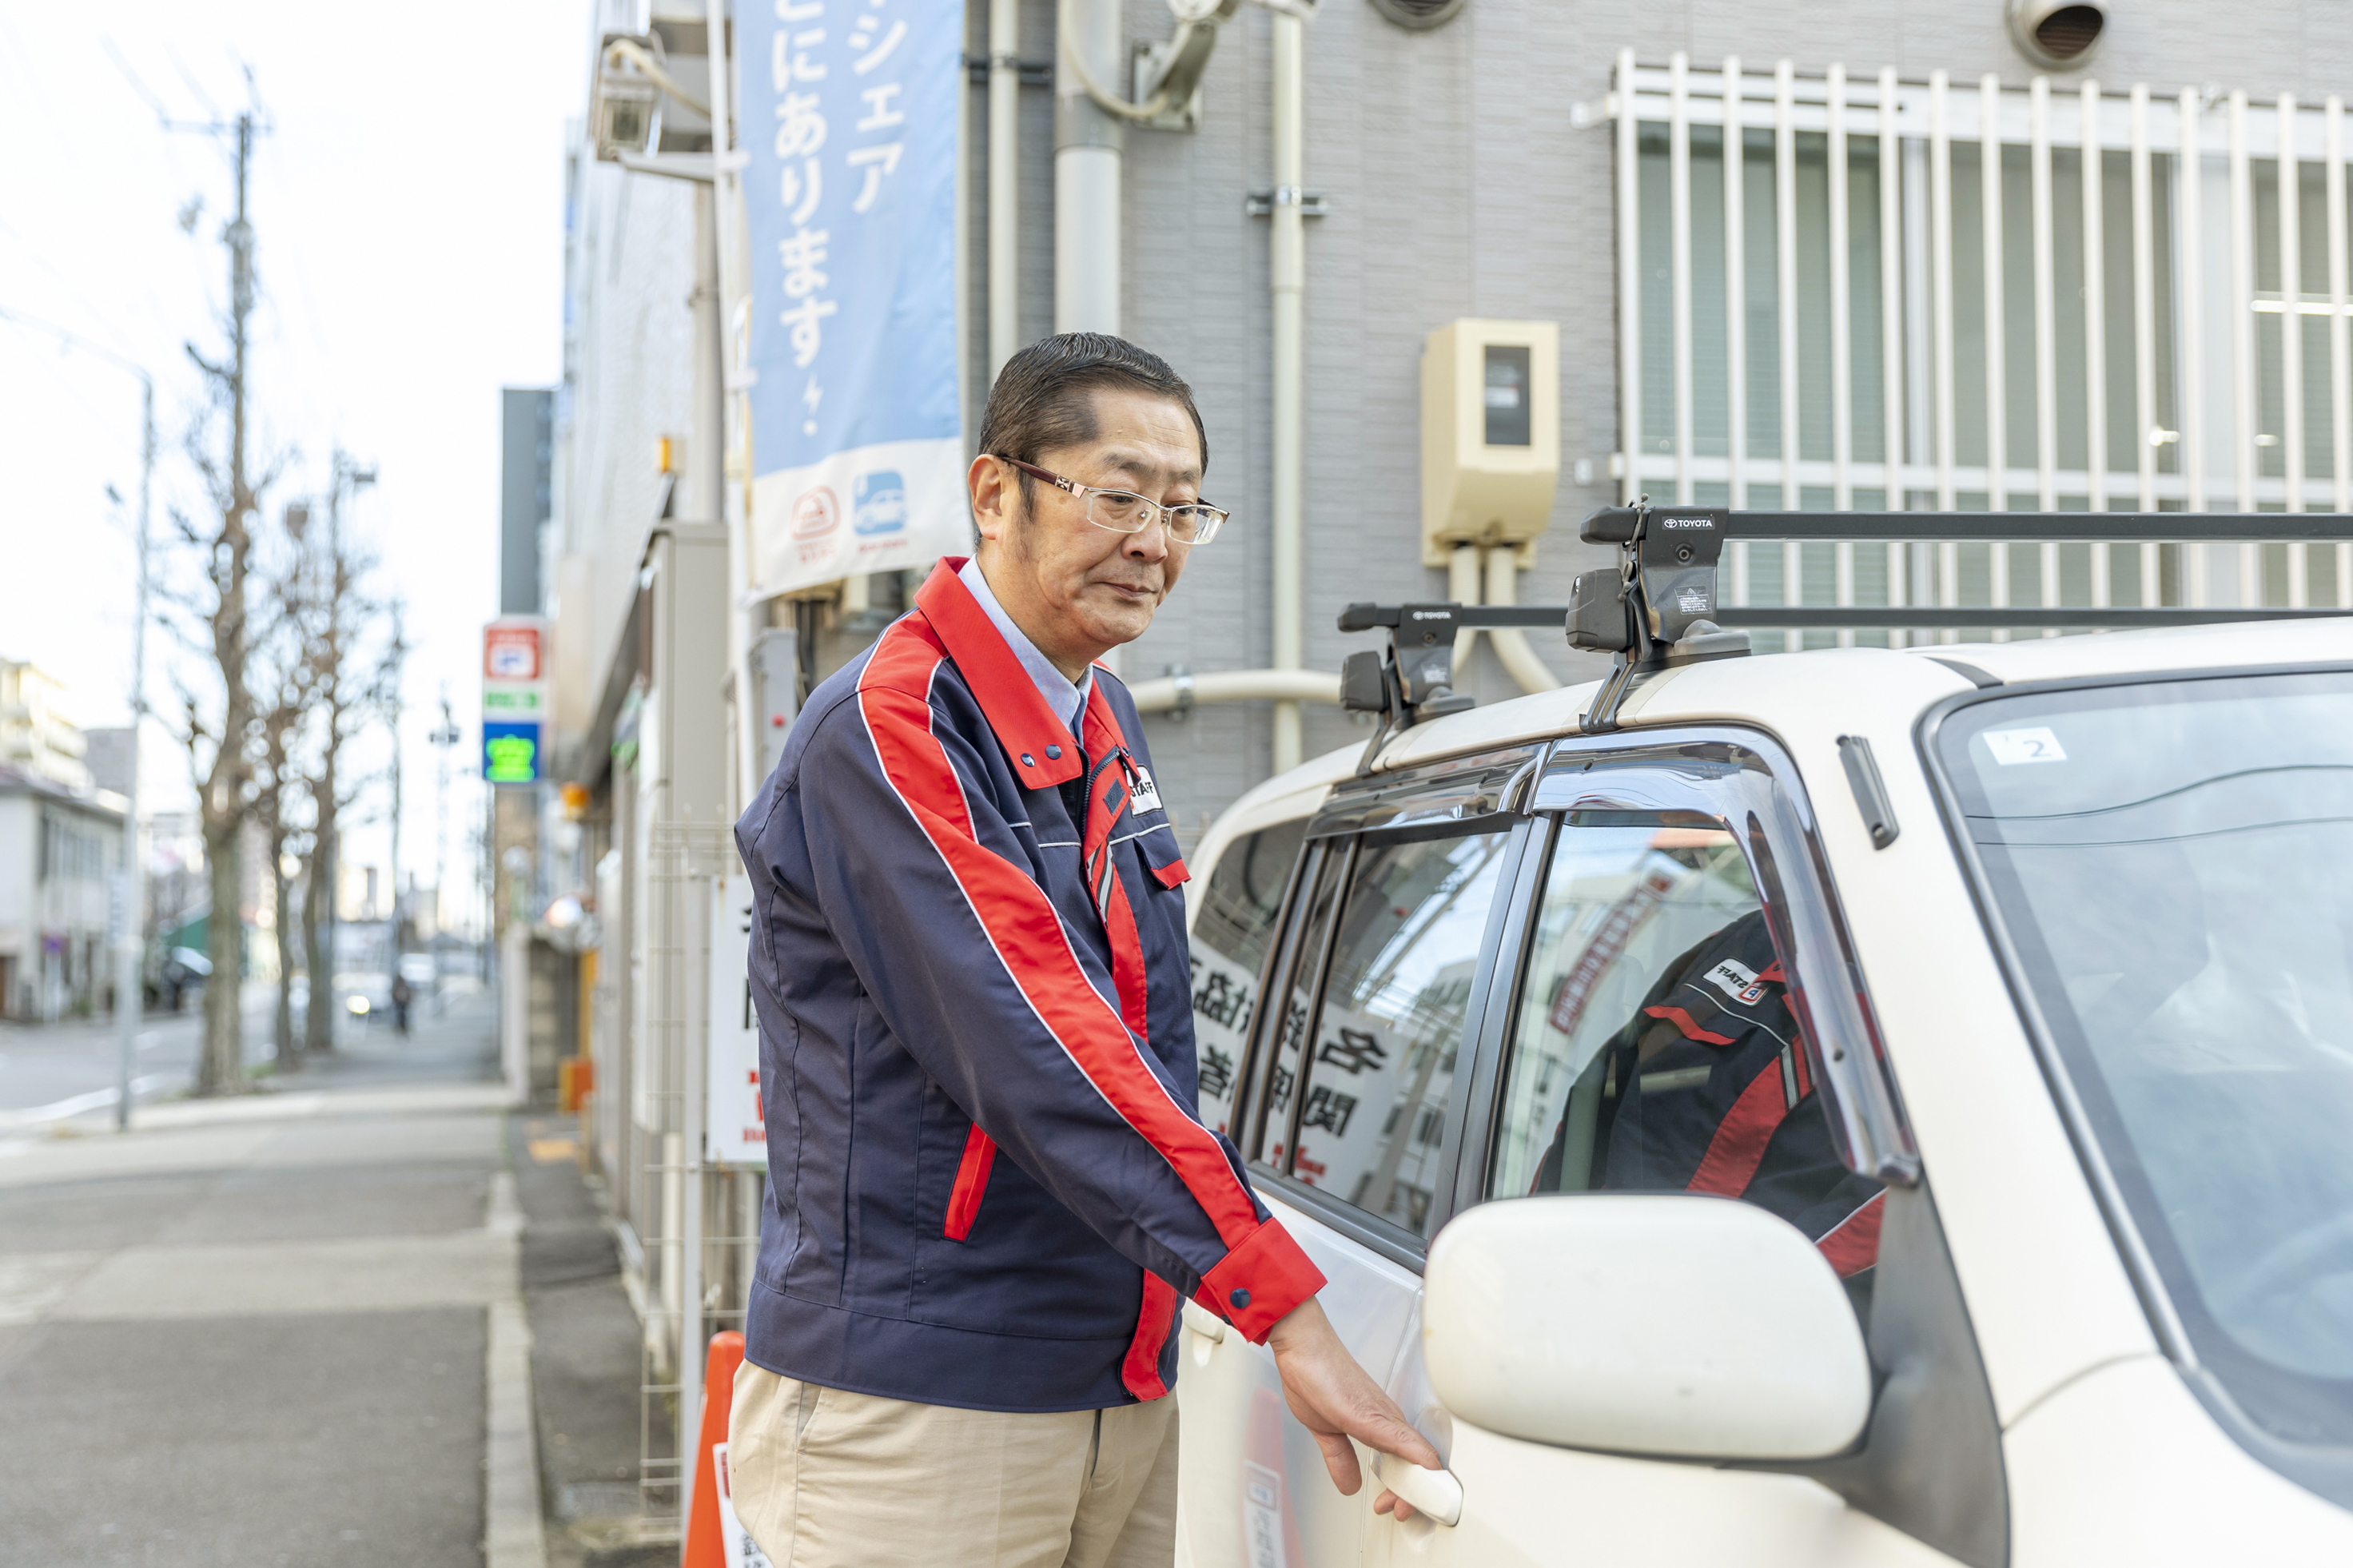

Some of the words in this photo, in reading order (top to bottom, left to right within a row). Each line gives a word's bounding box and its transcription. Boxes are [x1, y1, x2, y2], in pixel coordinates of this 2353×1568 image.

[846, 0, 908, 214] シェア
[2022, 739, 2052, 758] 2
[1129, 782, 1153, 797] STAFF
